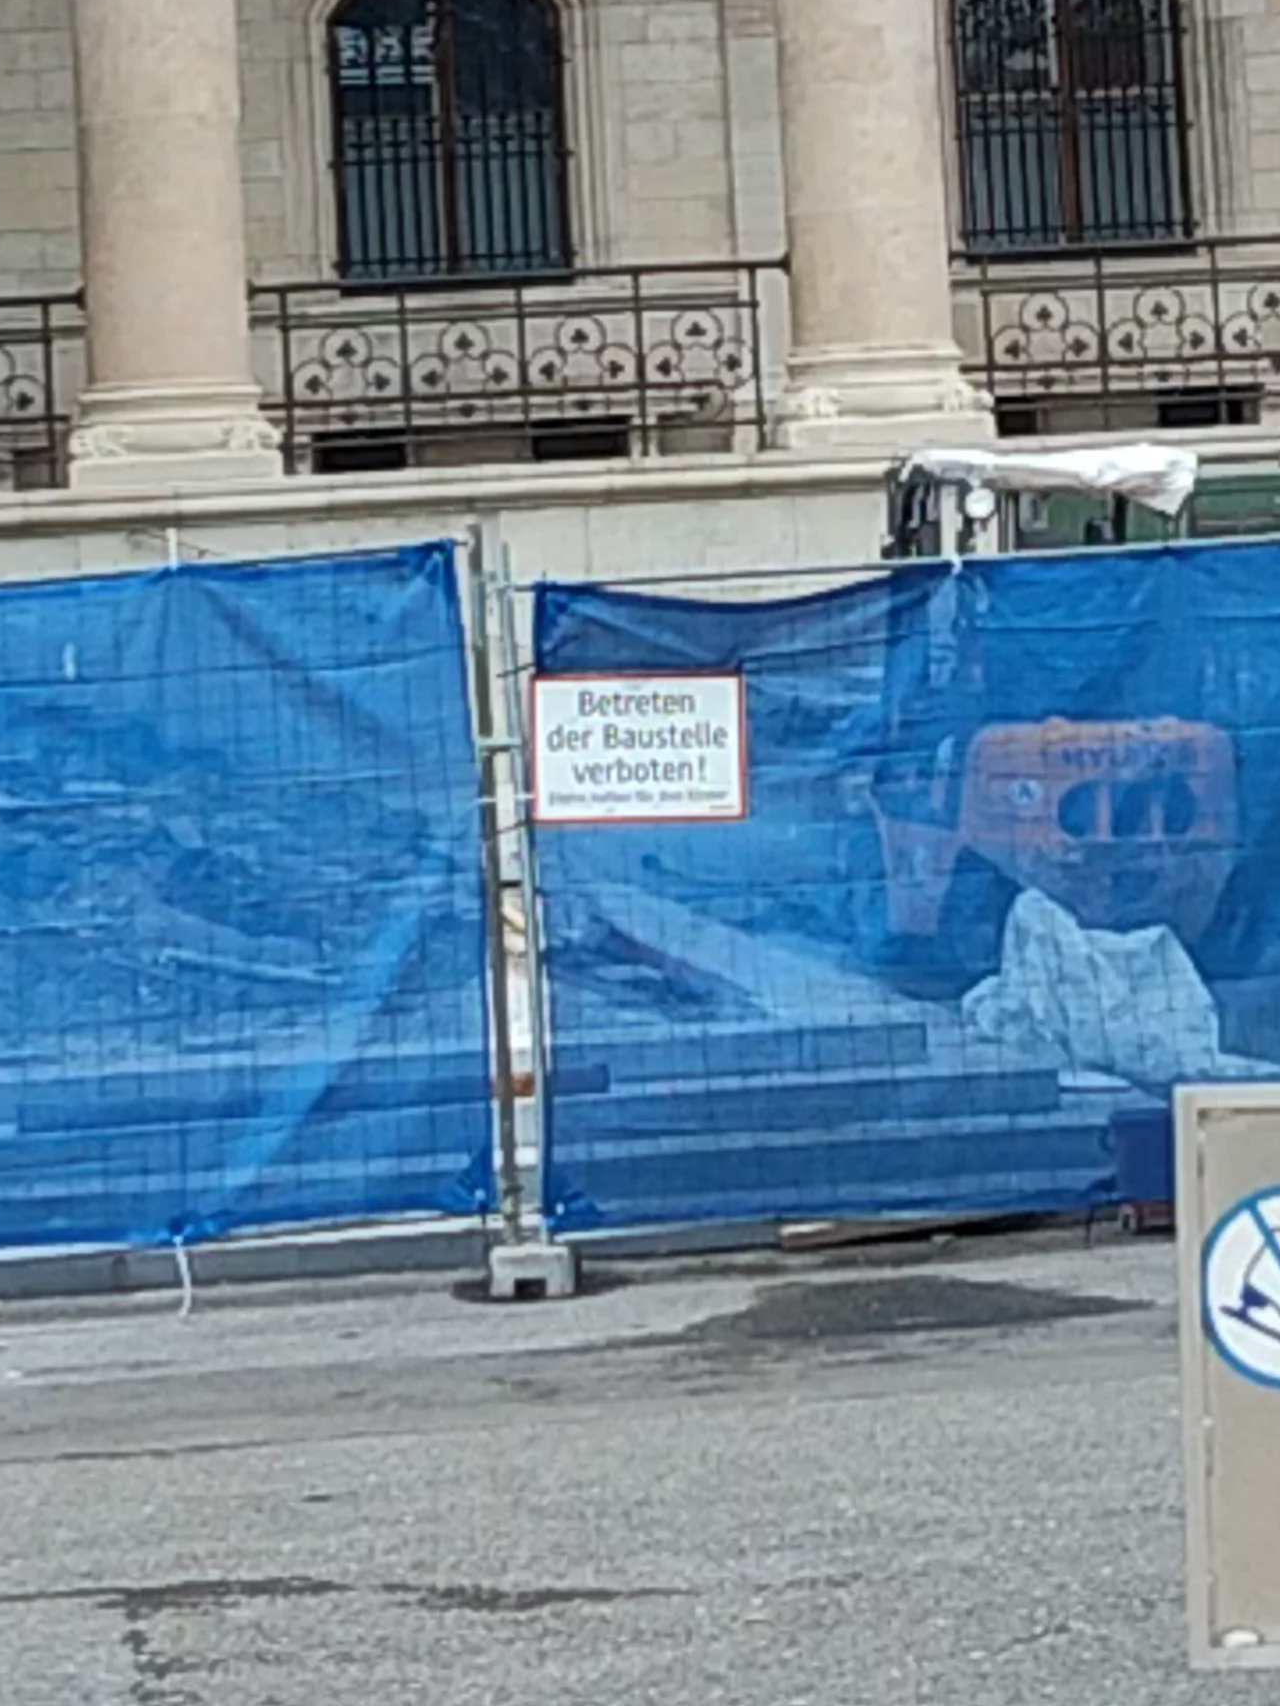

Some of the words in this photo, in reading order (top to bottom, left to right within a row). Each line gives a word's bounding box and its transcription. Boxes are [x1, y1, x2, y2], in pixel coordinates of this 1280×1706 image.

[577, 689, 696, 718] Betreten
[546, 723, 593, 753] der
[602, 720, 729, 751] Baustelle
[570, 754, 707, 785] verboten!
